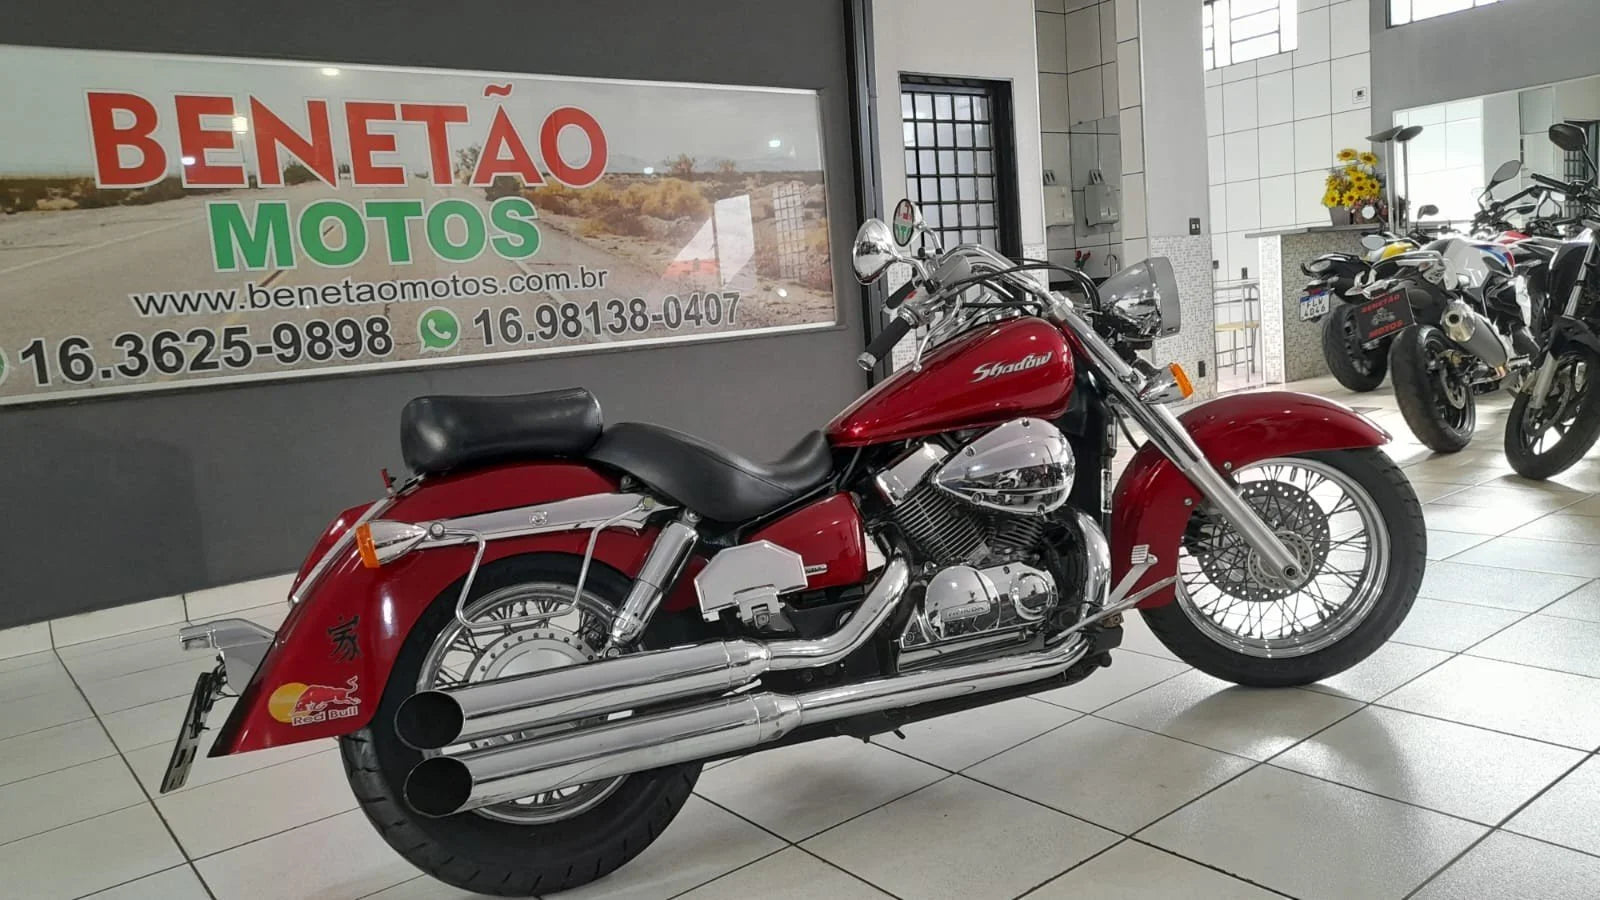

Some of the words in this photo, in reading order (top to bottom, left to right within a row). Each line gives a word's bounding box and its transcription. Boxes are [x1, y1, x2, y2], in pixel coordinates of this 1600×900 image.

[86, 83, 609, 188] BENETÃO
[208, 198, 541, 271] MOTOS
[133, 266, 609, 316] www.benetaomotos.com.br
[20, 316, 393, 386] 16.3625-9898
[474, 293, 740, 346] 16.98138-0407
[969, 351, 1053, 383] Shadow
[292, 711, 326, 726] Red
[329, 706, 358, 720] Bull
